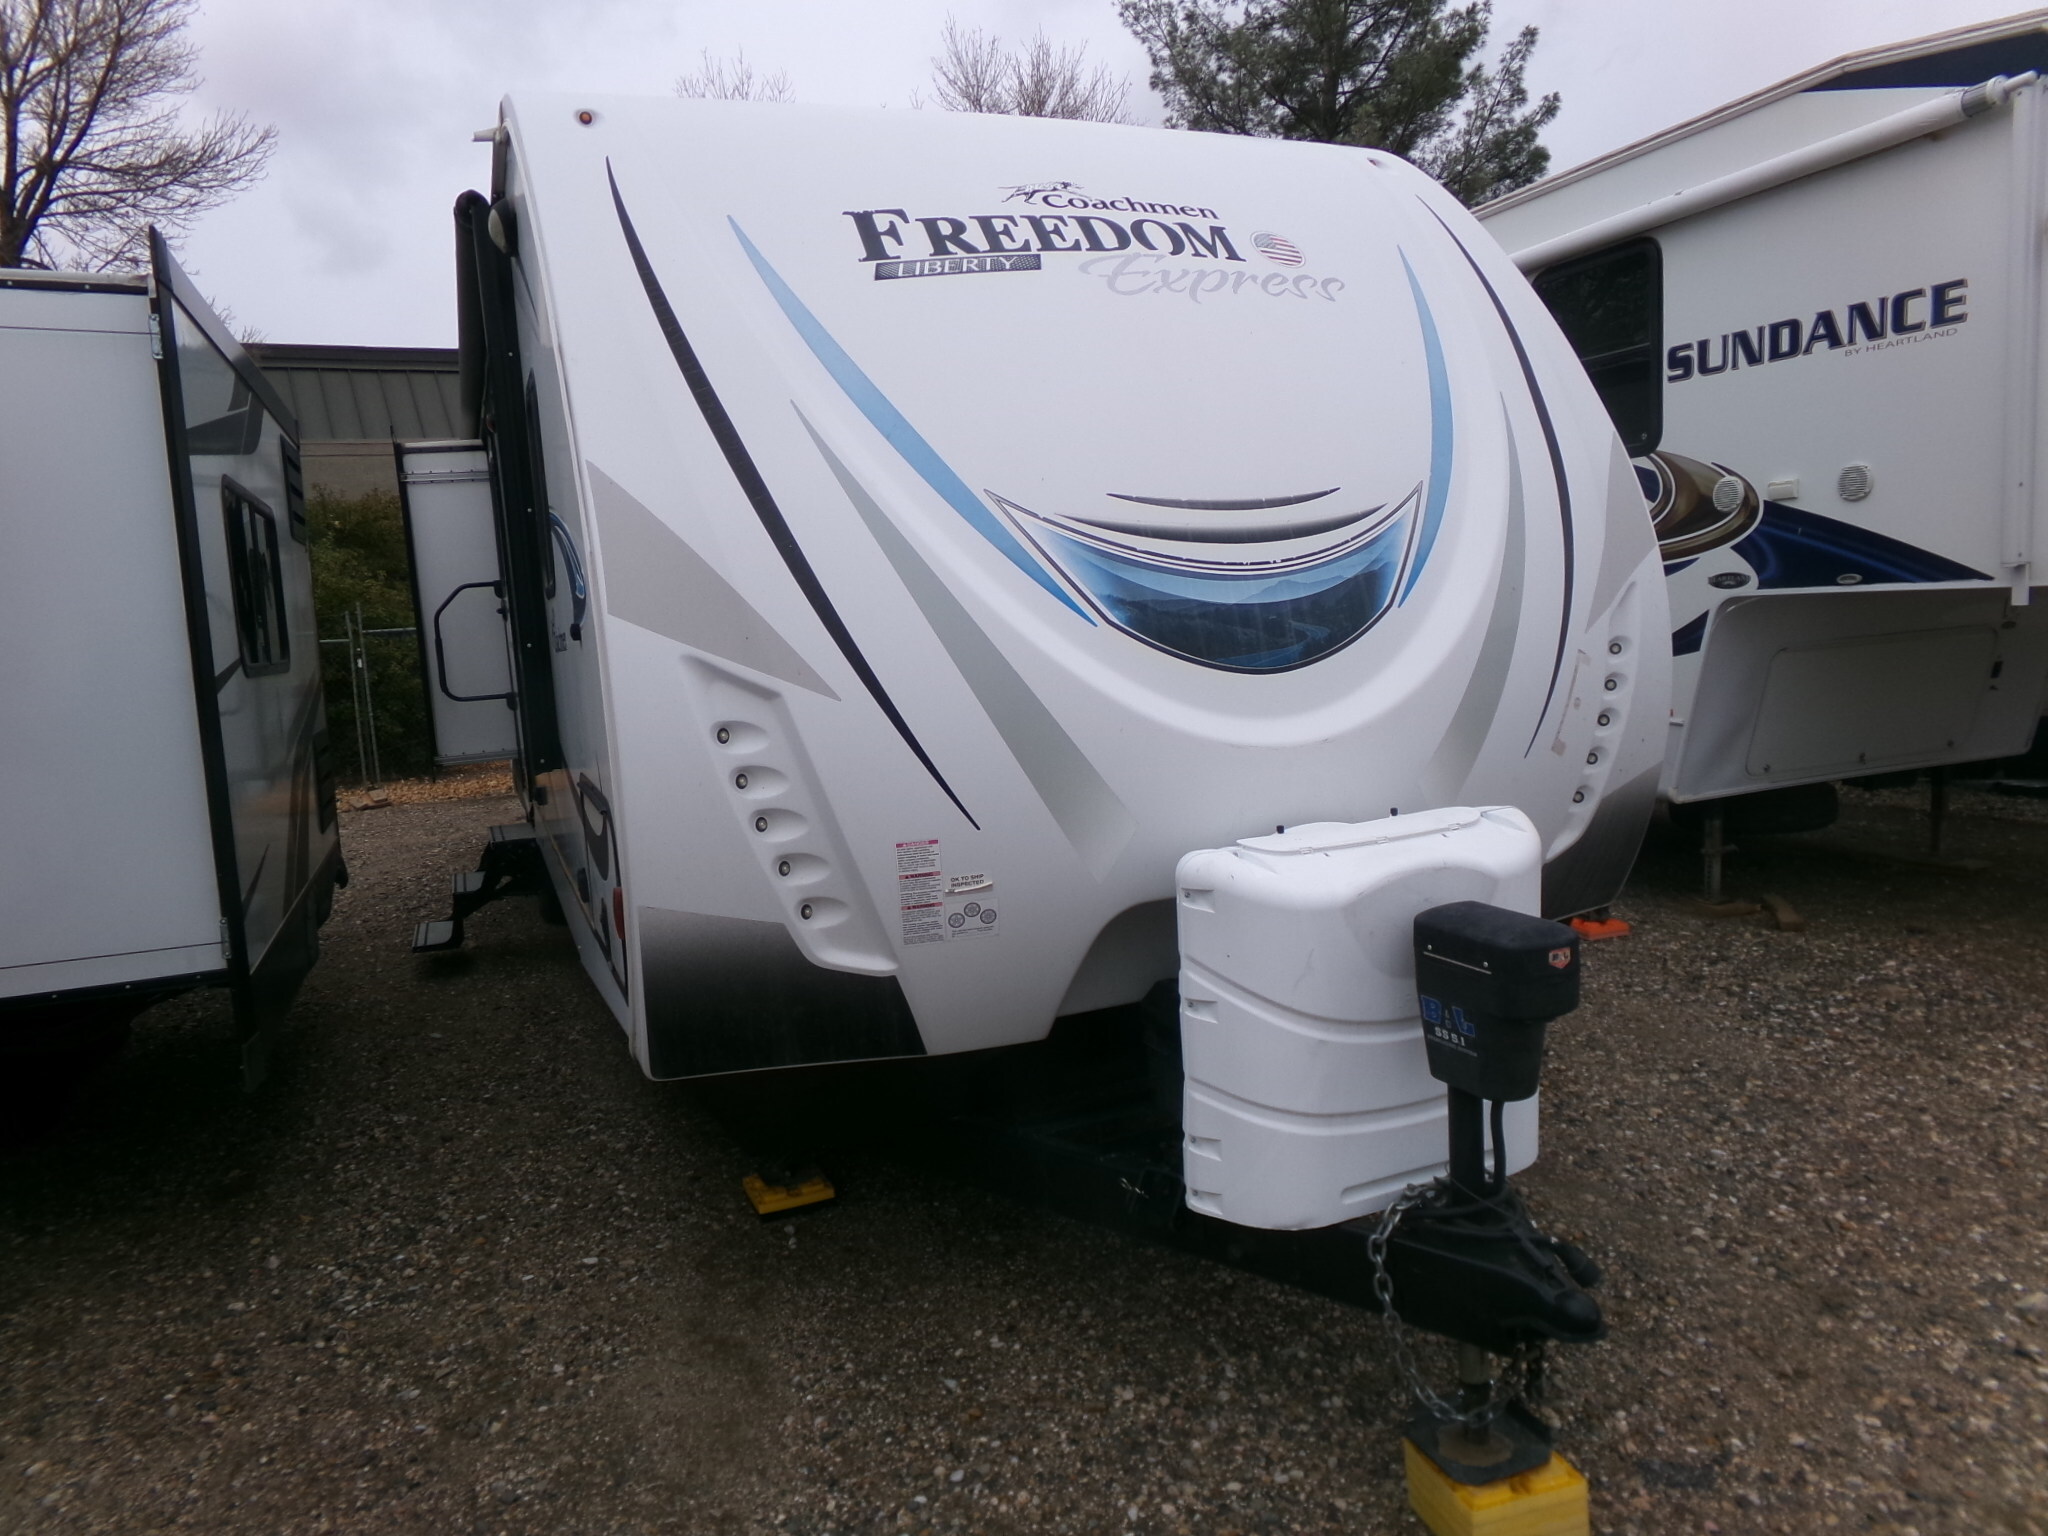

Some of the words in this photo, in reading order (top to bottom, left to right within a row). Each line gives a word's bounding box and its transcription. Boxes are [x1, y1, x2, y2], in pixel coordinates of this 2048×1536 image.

[1041, 192, 1220, 221] Coachmen
[842, 208, 1247, 263] FREEDOM
[896, 256, 1017, 278] LIBERTY
[1078, 253, 1345, 305] Express
[1667, 278, 1968, 384] SUNDANCE
[1844, 347, 1861, 358] BY
[1865, 328, 1958, 353] HEARTLAND
